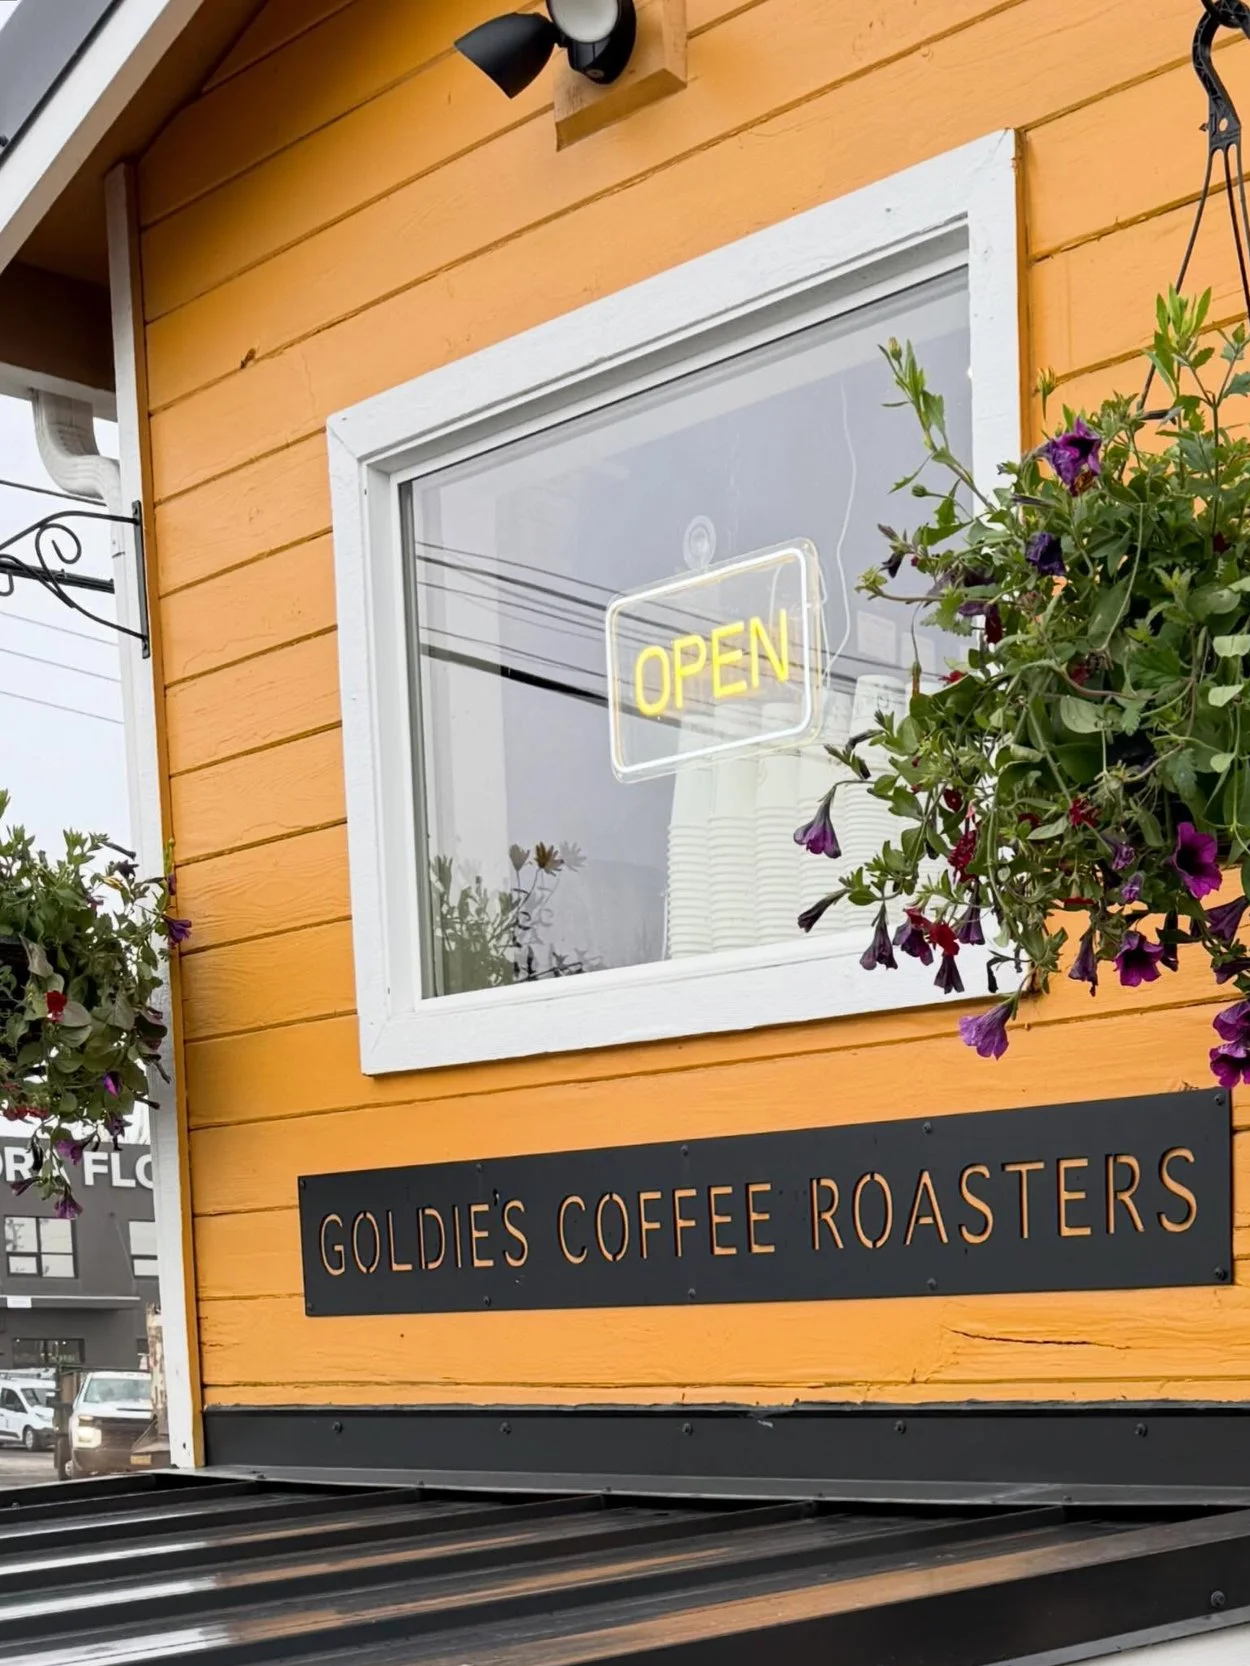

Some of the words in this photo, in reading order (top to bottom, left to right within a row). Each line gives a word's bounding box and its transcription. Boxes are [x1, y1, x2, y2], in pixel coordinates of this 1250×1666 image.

[635, 607, 790, 716] OPEN
[557, 1182, 777, 1265] COFFEE
[810, 1145, 1198, 1251] ROASTERS
